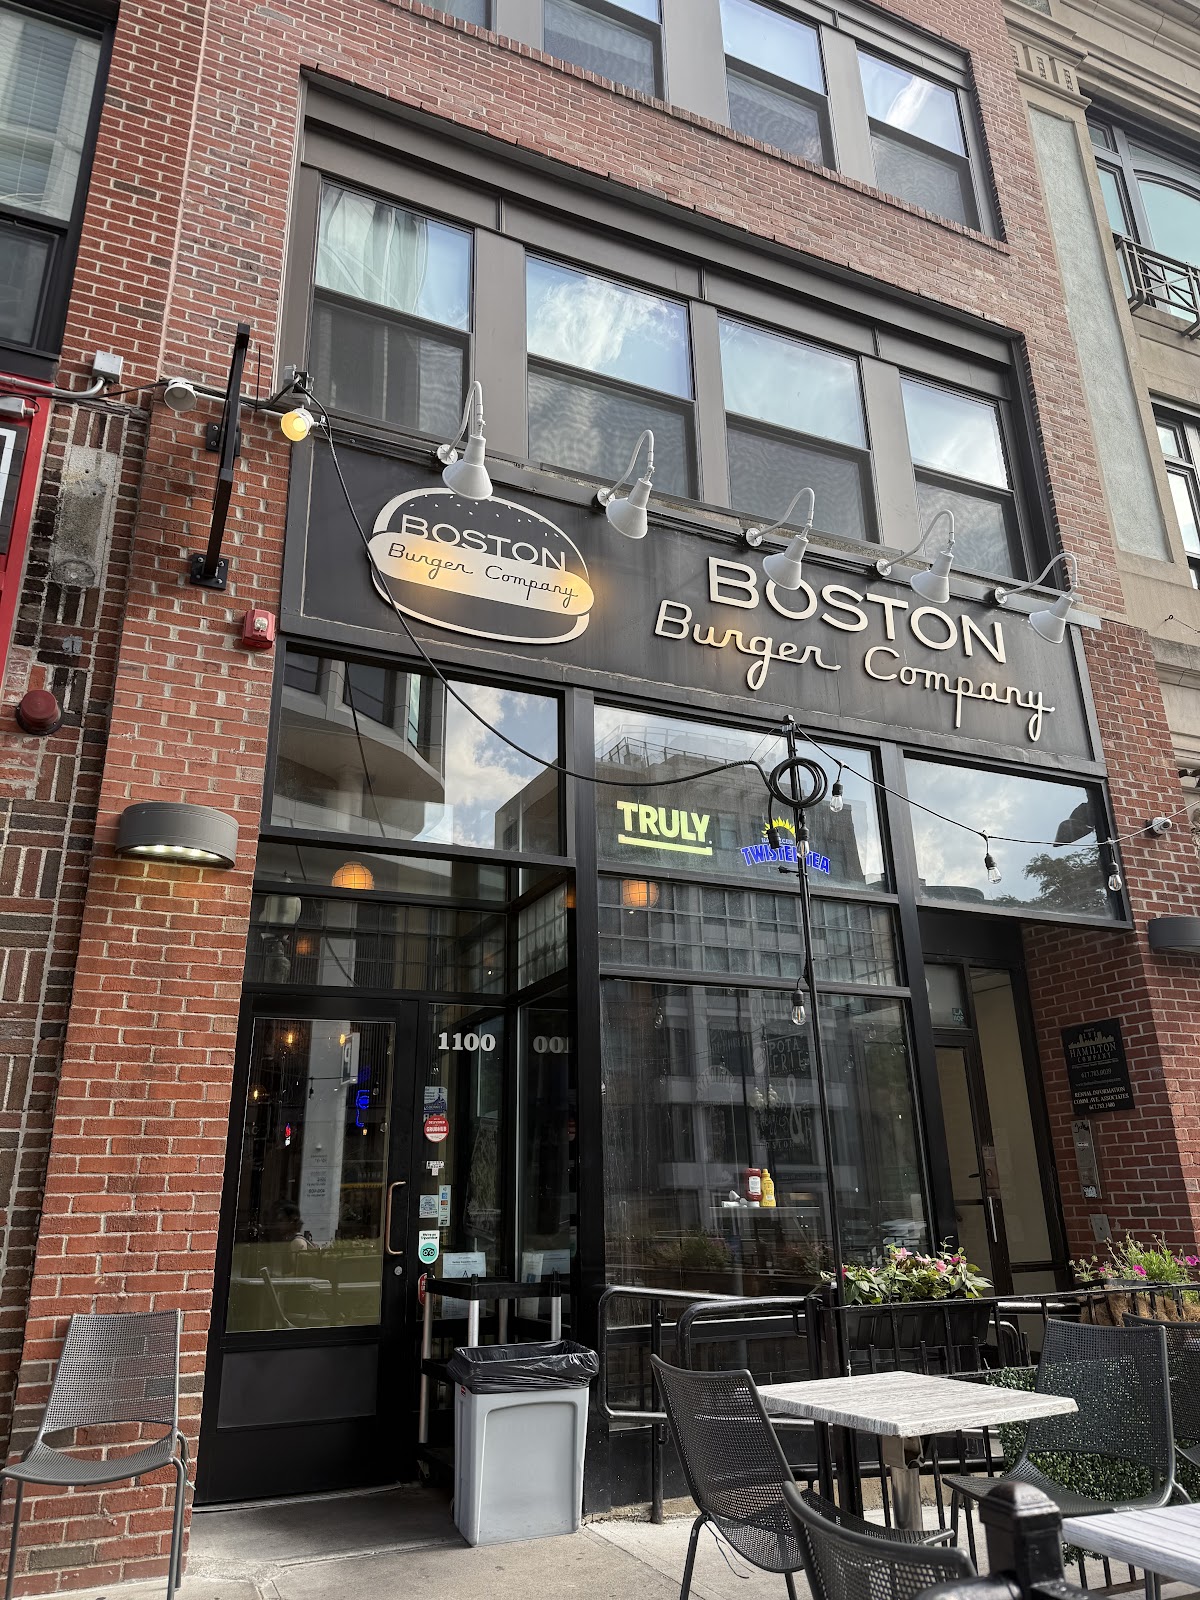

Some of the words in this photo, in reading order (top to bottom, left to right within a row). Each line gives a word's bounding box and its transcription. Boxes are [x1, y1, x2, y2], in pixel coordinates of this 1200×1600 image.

[401, 514, 566, 571] BOSTON
[388, 542, 474, 580] Burger
[485, 565, 579, 608] Company
[708, 556, 1007, 664] BOSTON
[654, 599, 842, 691] Burger
[864, 646, 1056, 742] Company
[616, 800, 710, 843] TRULY
[438, 1032, 496, 1052] 1100
[1069, 1041, 1117, 1058] HAMILTON
[1078, 1052, 1111, 1063] COMPANY
